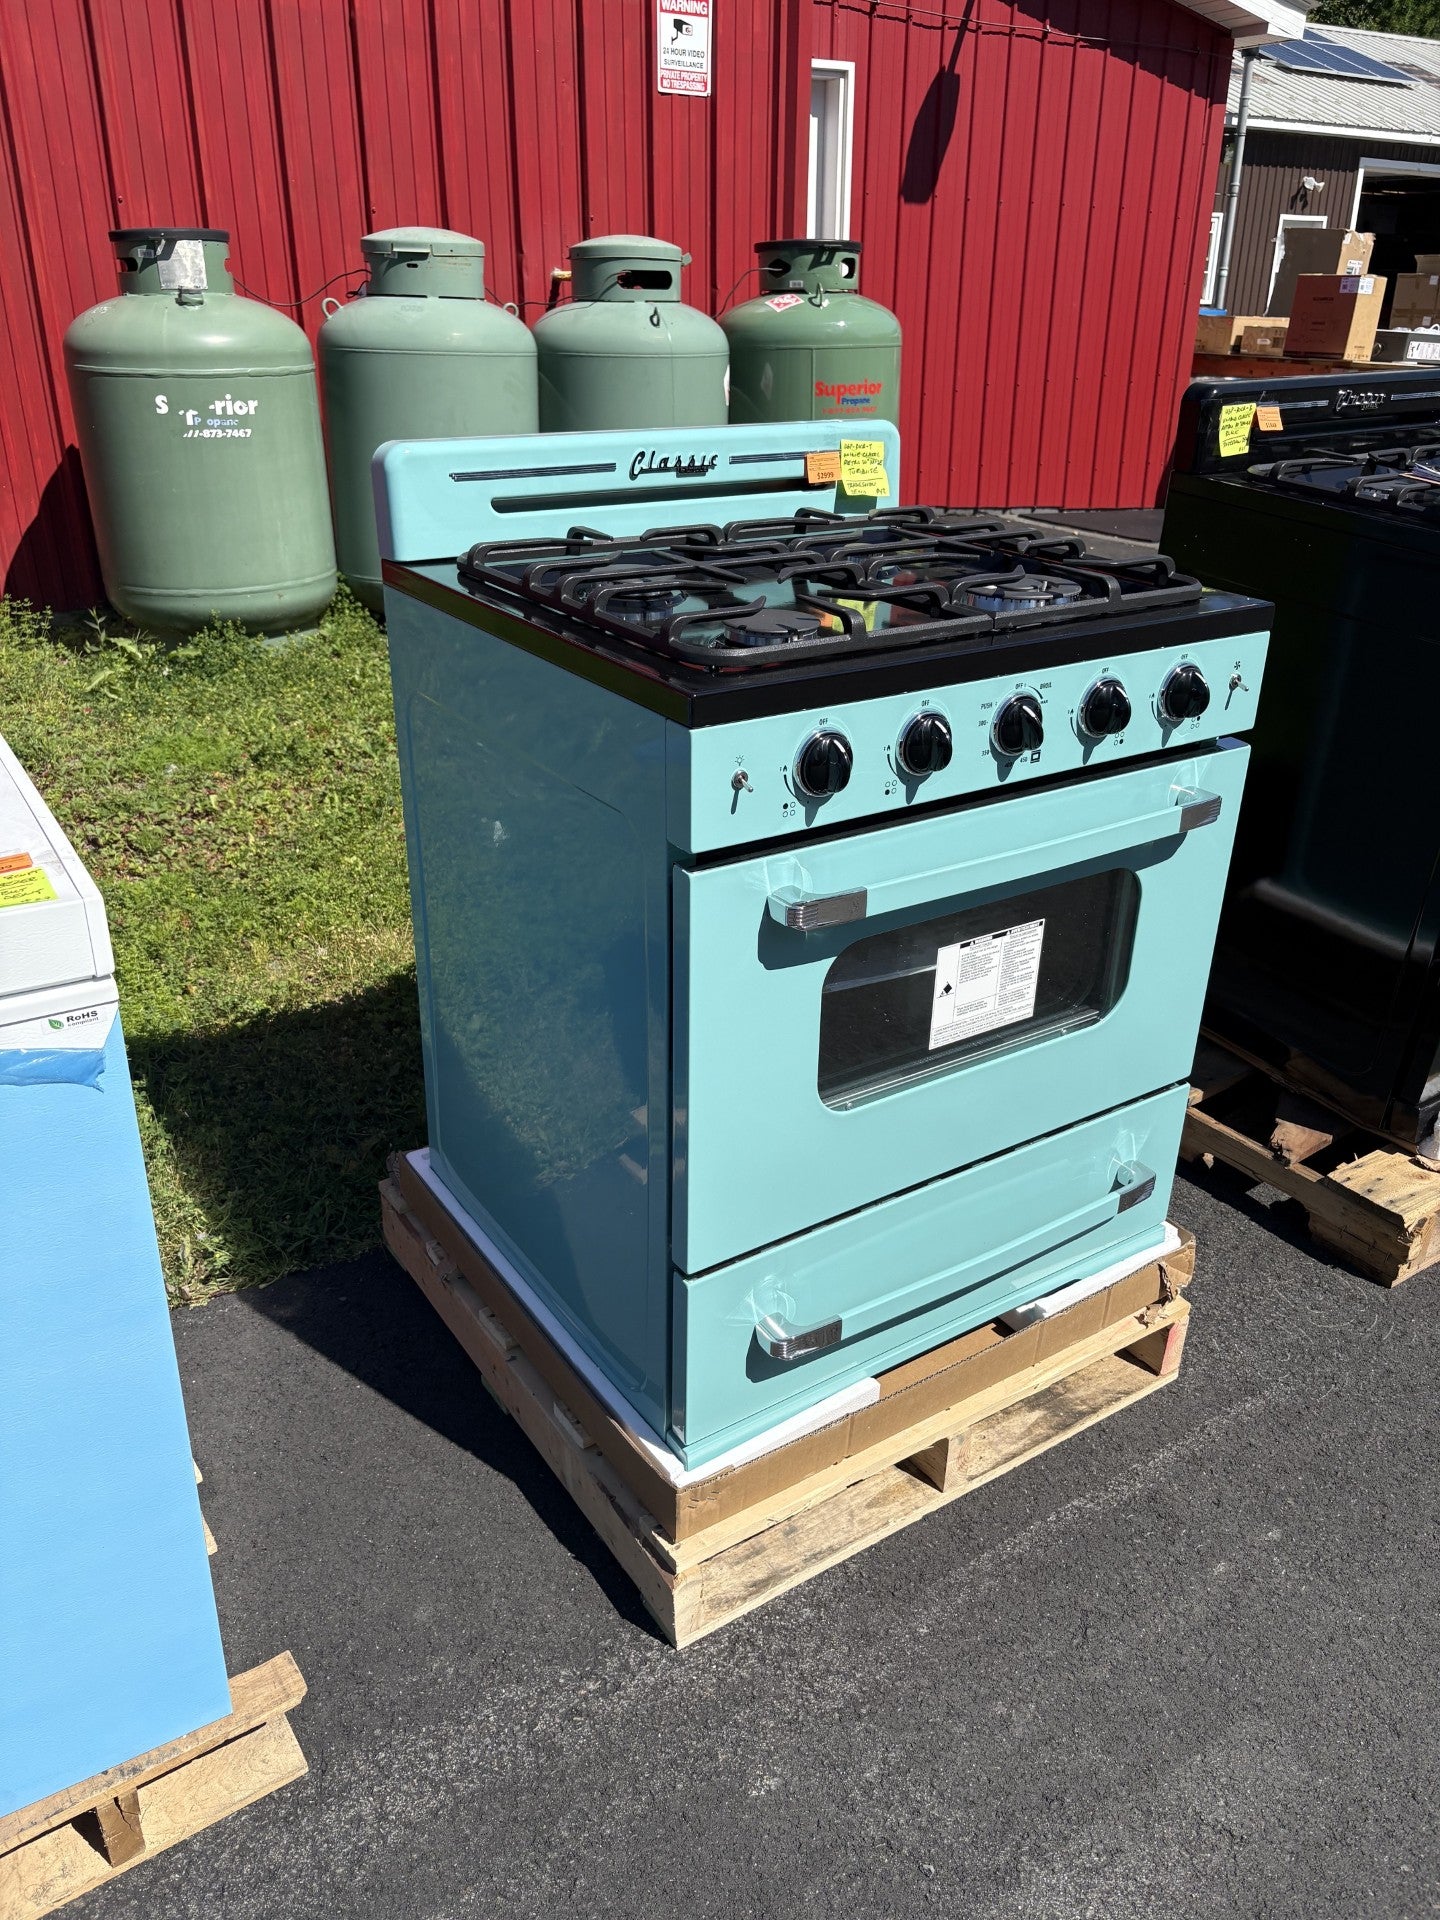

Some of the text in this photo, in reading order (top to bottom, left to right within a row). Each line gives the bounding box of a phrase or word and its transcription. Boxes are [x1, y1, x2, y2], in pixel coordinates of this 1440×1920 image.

[661, 0, 708, 15] WARNING
[663, 47, 705, 58] 24 HOUR VIDEO
[664, 58, 703, 69] SURVEILLANCE
[661, 69, 680, 79] PRIVATE
[662, 78, 706, 91] NO TRESPASSING
[815, 379, 882, 405] Superior
[841, 397, 870, 407] Propane
[630, 449, 719, 478] Classic
[1015, 682, 1024, 690] OFF
[921, 699, 930, 707] OFF
[980, 702, 993, 710] PUSH
[819, 717, 828, 726] OFF
[66, 1010, 98, 1023] RoHS
[67, 1017, 99, 1027] compliant
